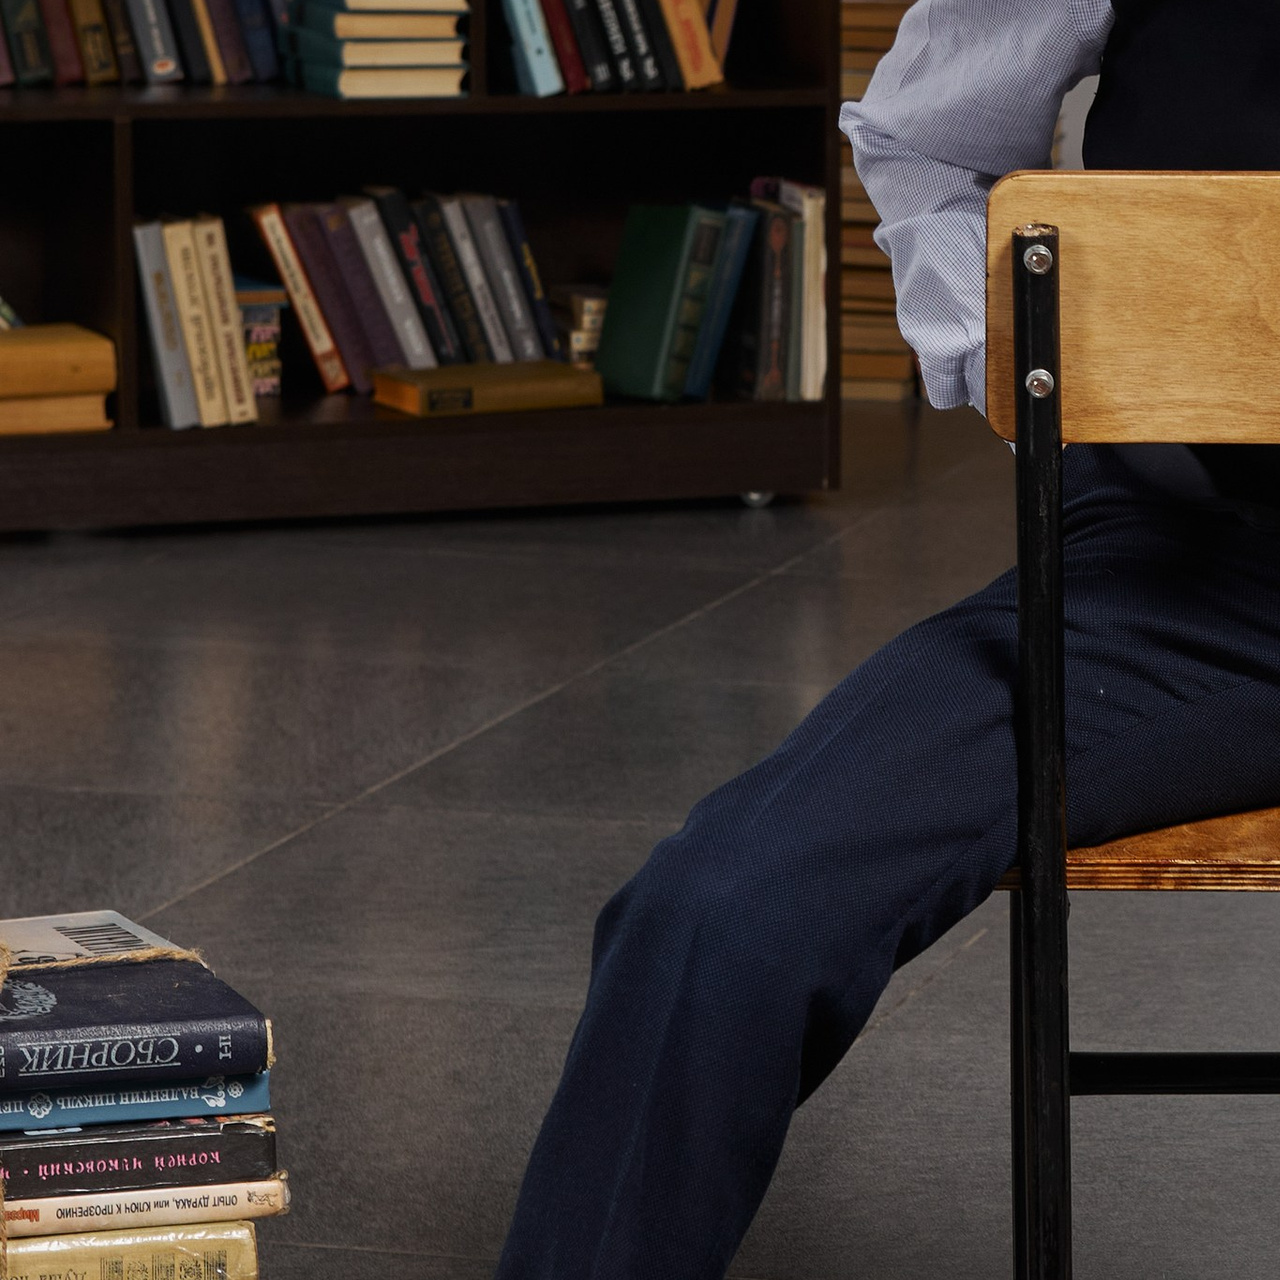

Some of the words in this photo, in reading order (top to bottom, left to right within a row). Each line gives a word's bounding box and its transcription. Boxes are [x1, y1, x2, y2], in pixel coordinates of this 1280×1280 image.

[19, 1036, 180, 1073] СБОРНИК
[56, 1093, 117, 1110] ПИКУЛЬ
[119, 1087, 200, 1105] ВАЛЕНТИН
[124, 1201, 152, 1214] КЛЮЧ
[153, 1199, 170, 1209] или
[212, 1194, 238, 1208] ОПЫТ
[56, 1204, 114, 1220] ПРОЗРЕНИЮ
[115, 1203, 122, 1215] К
